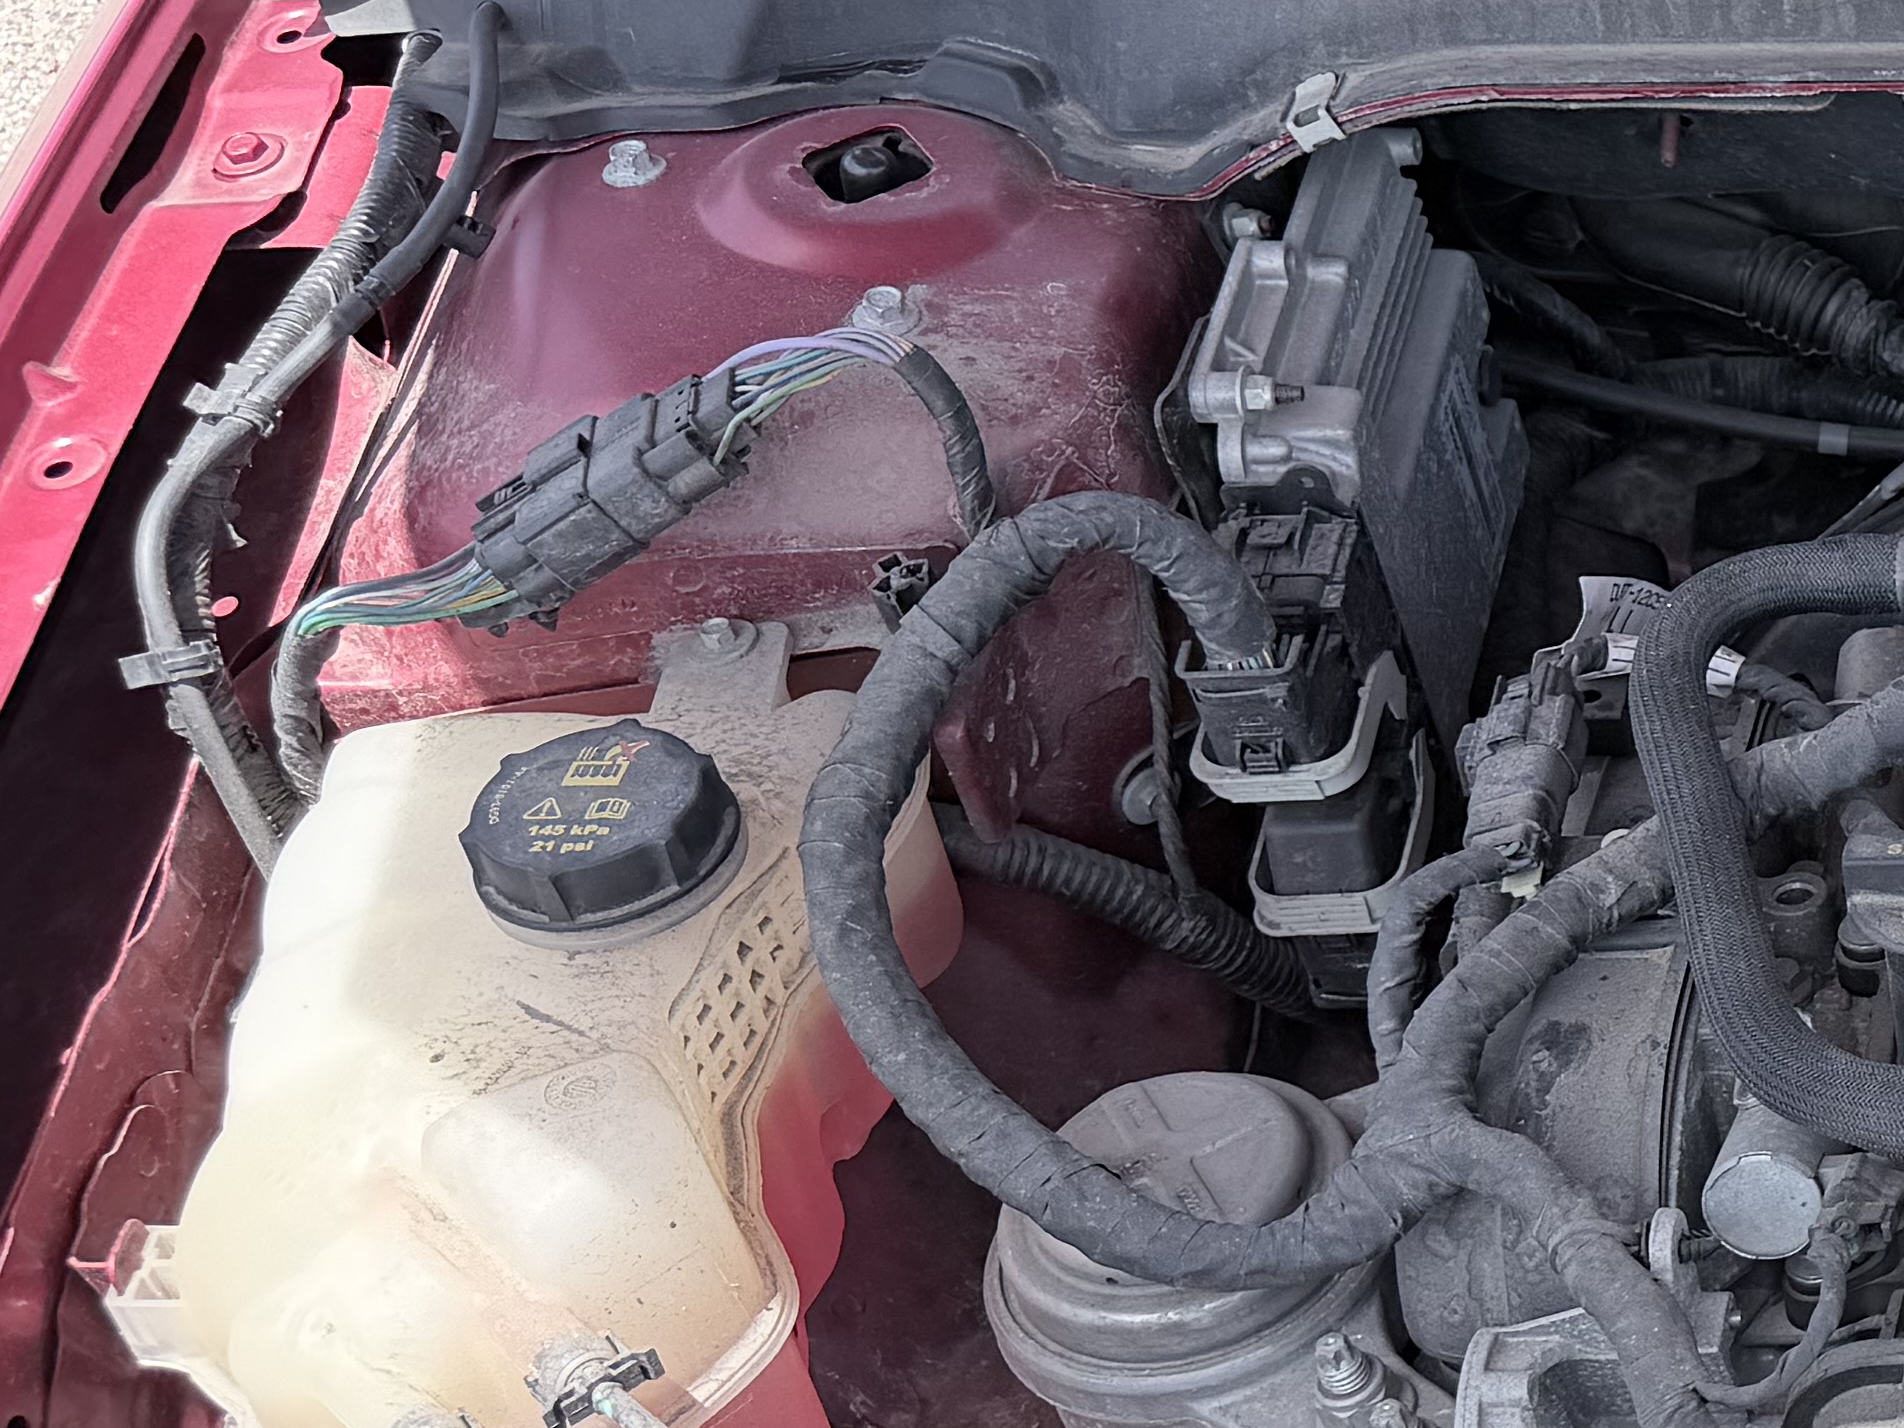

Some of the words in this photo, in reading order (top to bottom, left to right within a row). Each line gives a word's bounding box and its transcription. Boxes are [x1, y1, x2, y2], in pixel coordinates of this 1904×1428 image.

[528, 825, 567, 836] 145
[570, 825, 611, 836] kPa
[528, 840, 556, 853] 21
[560, 840, 595, 854] psi
